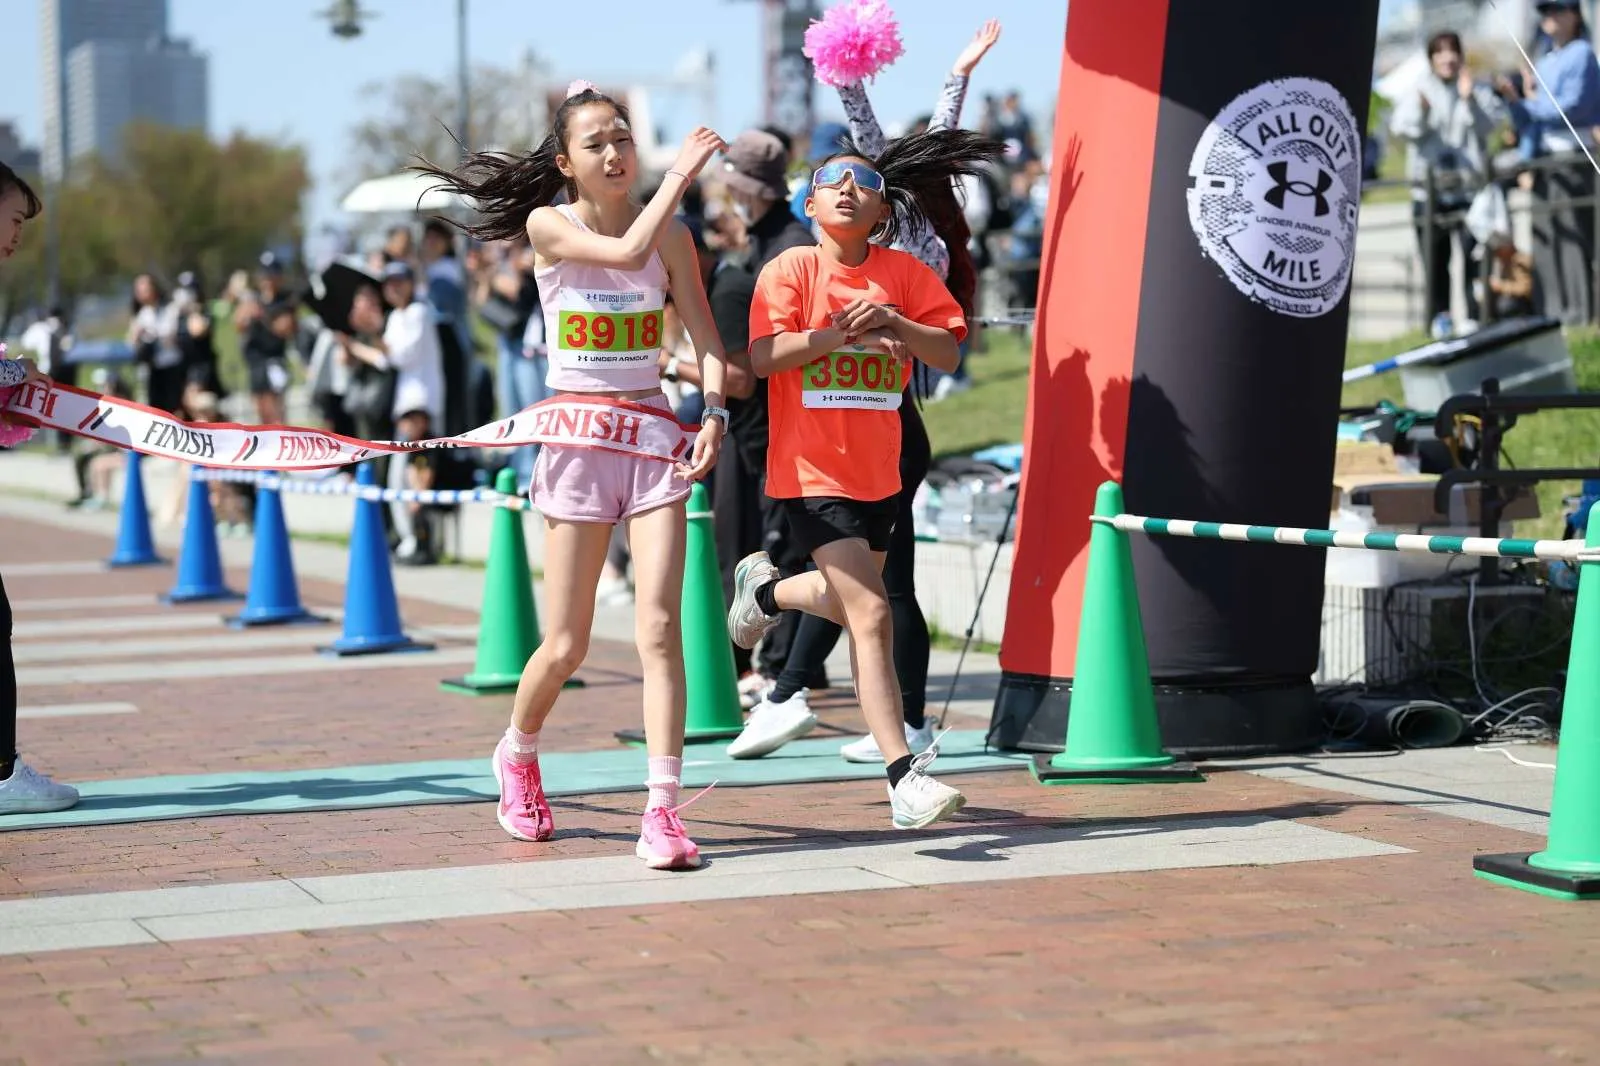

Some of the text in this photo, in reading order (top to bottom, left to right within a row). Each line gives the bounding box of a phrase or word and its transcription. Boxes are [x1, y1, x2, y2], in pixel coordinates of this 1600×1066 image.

[1258, 112, 1347, 159] ALL OUT
[1256, 216, 1331, 236] UNDER ARMOUR
[1262, 250, 1321, 282] MILE
[566, 314, 658, 349] 3918
[810, 355, 897, 390] 3905
[143, 420, 215, 458] FINISH
[530, 408, 642, 445] FINISH
[276, 435, 341, 461] FINISH
